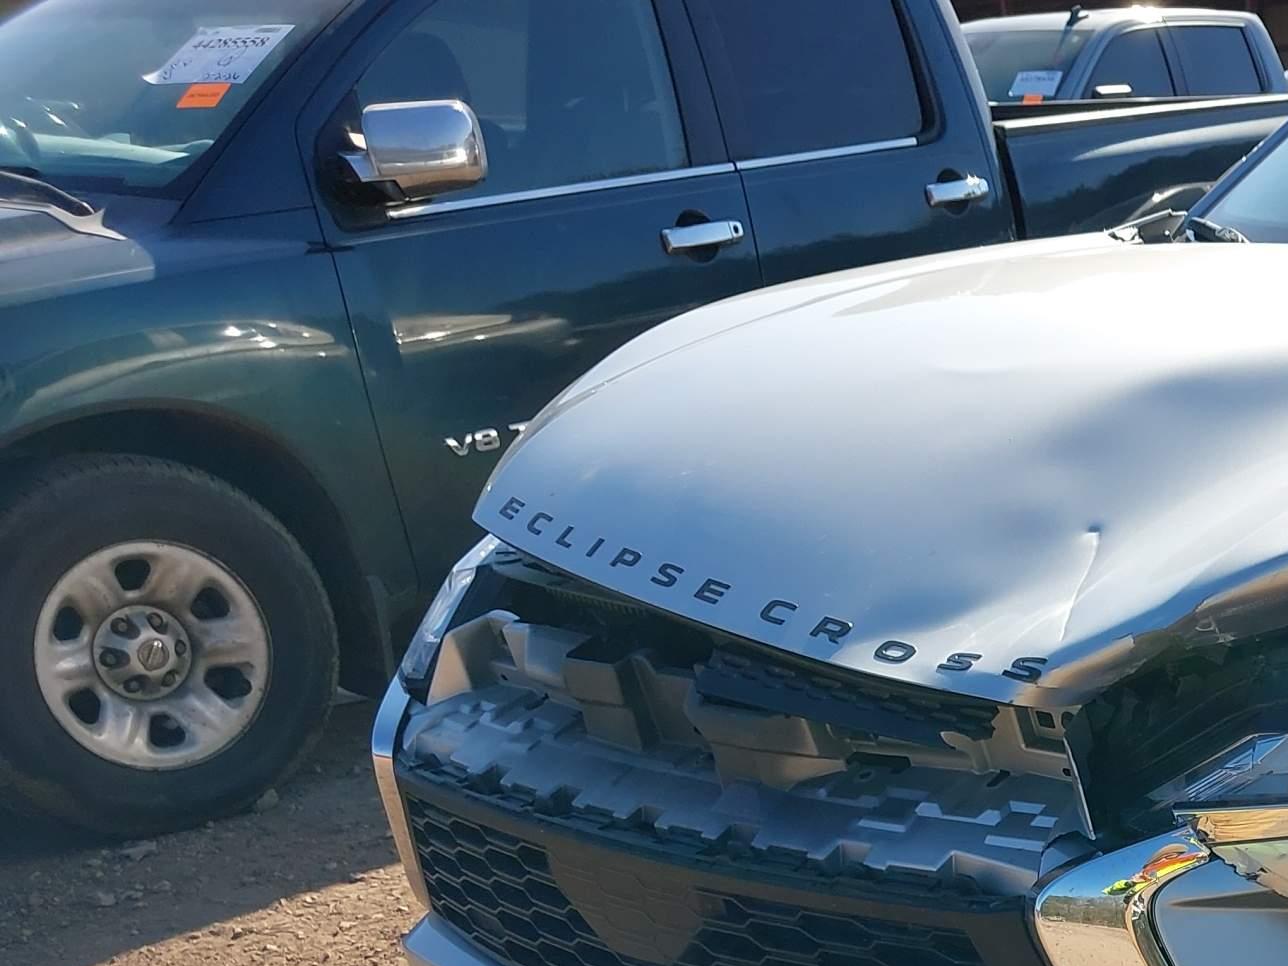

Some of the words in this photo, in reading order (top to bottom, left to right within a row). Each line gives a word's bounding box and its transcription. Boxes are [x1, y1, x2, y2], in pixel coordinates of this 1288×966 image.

[444, 428, 500, 456] V8
[498, 496, 731, 605] ECLIPSE
[758, 599, 1049, 684] CROSS
